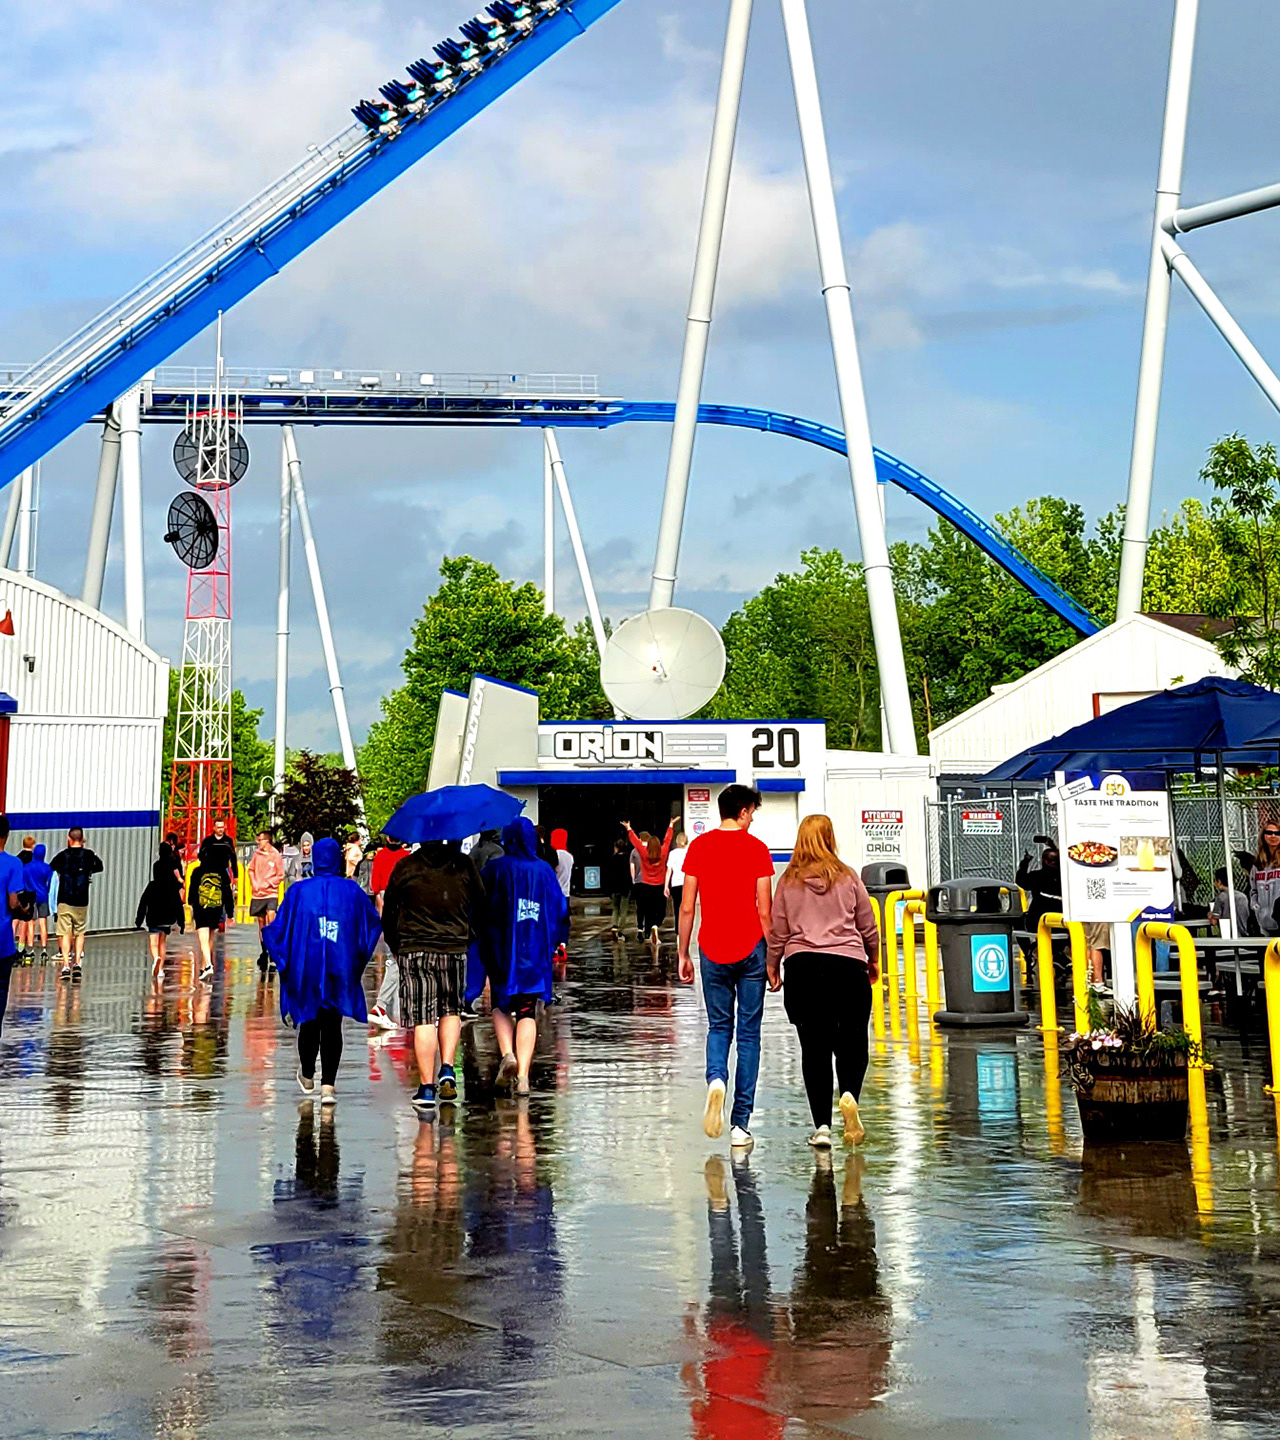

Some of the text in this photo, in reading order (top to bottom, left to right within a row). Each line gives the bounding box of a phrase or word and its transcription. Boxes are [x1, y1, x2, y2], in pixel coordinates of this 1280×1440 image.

[554, 725, 663, 763] ORION
[751, 727, 801, 768] 20
[1106, 783, 1125, 796] 50
[1074, 799, 1159, 808] TASTE THE TRADITION
[866, 841, 900, 853] ORION
